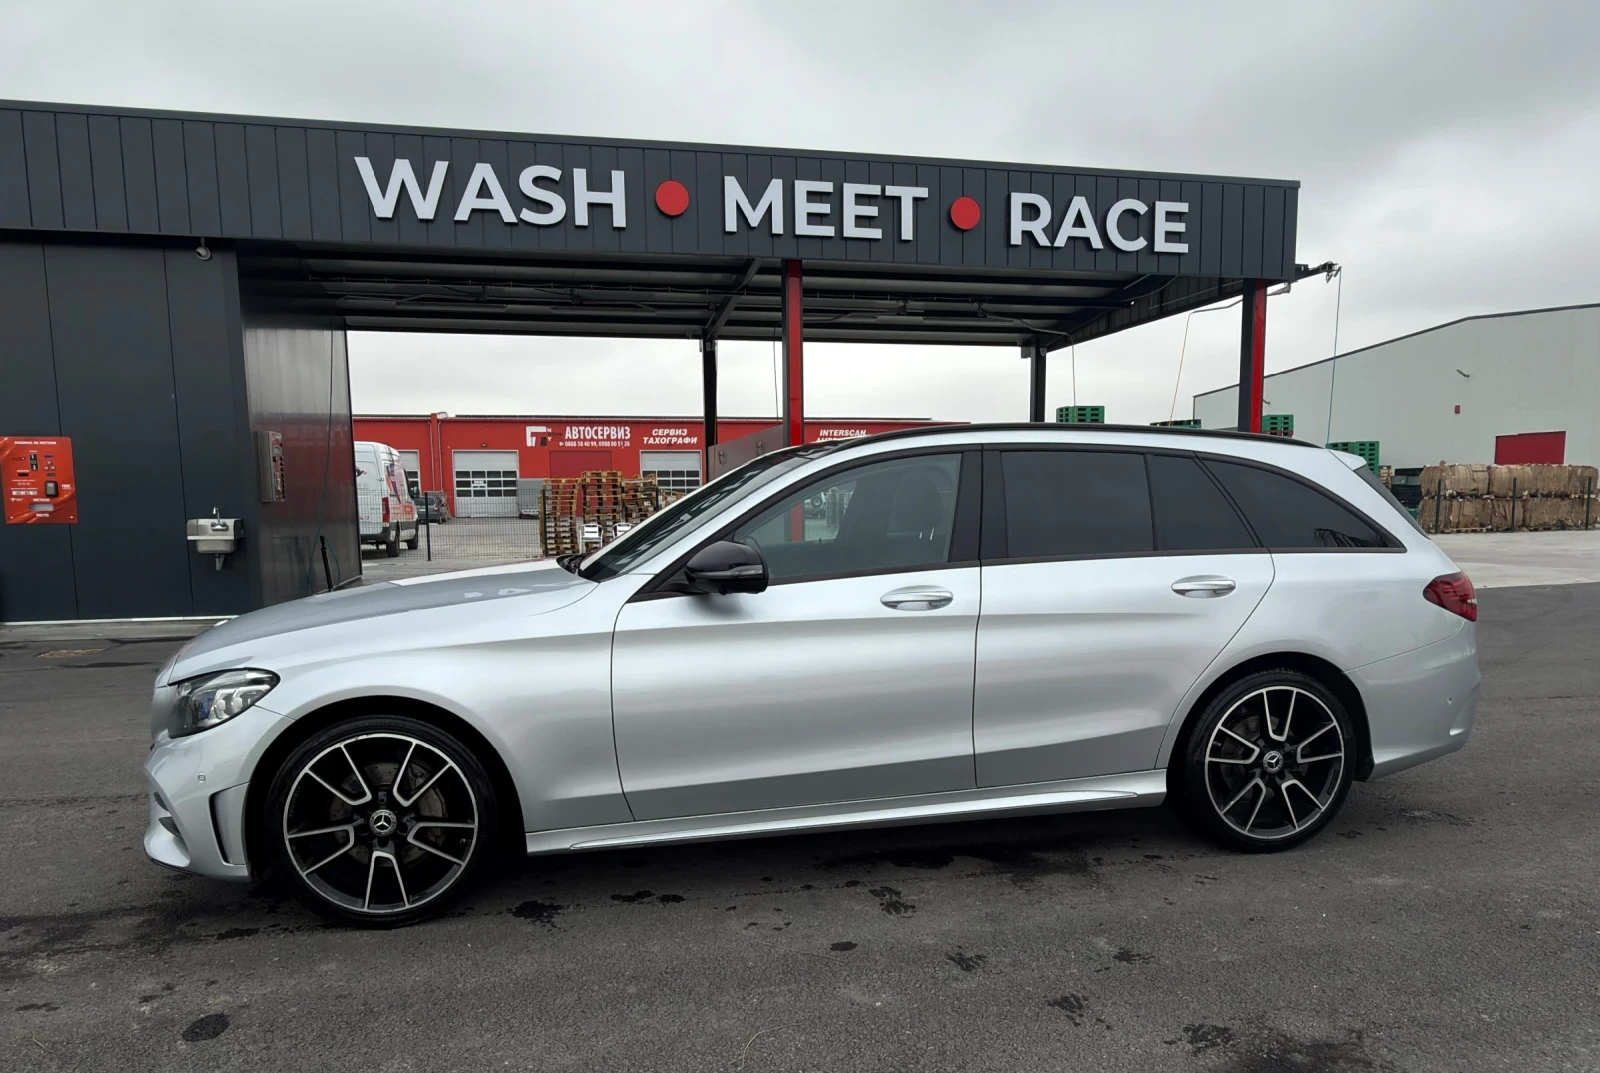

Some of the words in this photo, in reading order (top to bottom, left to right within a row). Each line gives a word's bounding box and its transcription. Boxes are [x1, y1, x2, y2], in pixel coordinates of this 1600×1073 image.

[354, 156, 626, 228] WASH
[724, 176, 928, 240] MEET
[1010, 192, 1189, 253] RACE
[565, 426, 631, 440] АВТОСЕРВИЗ
[652, 428, 688, 436] СЕРВИЗ
[819, 429, 867, 437] INTERSCAN
[642, 436, 698, 445] ТАХОГРАФИ
